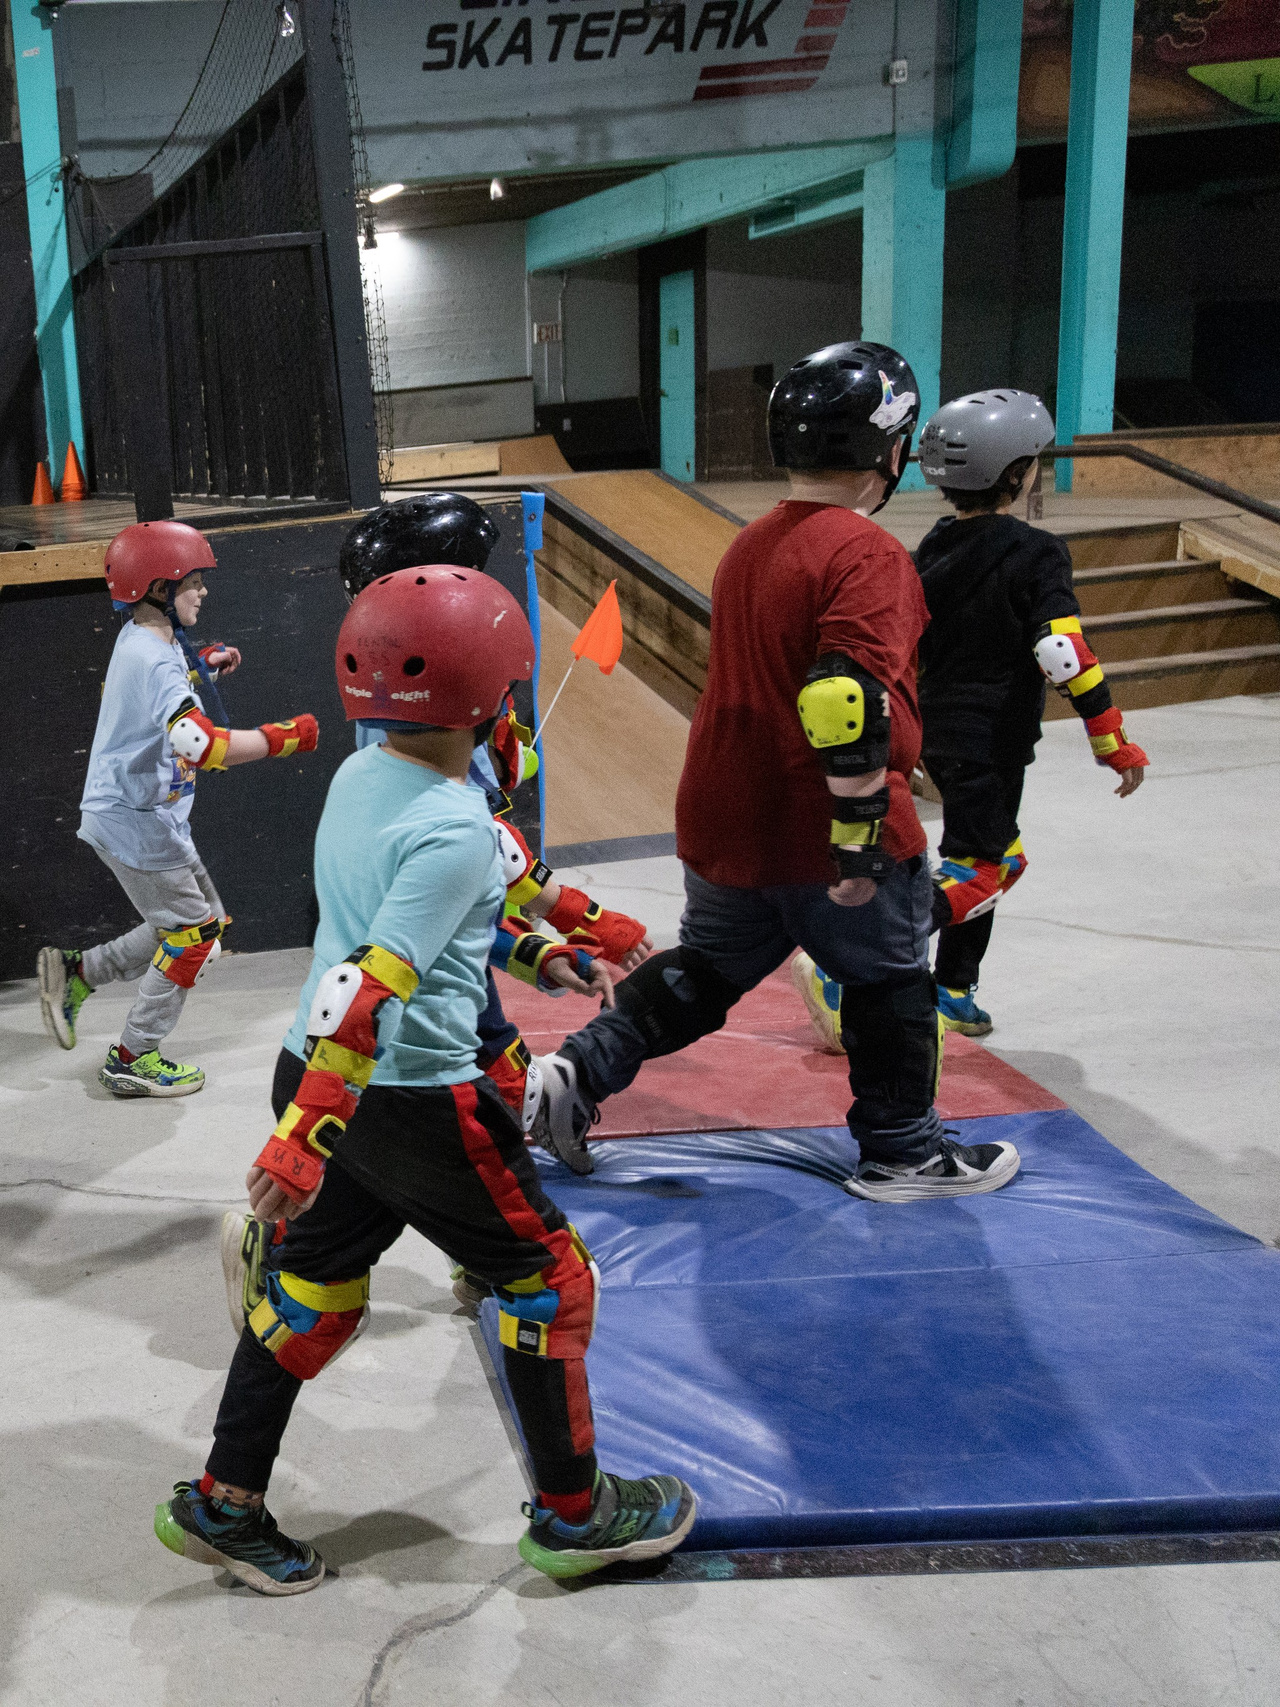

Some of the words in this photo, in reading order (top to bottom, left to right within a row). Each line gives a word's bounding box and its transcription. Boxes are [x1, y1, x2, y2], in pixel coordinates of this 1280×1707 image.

[422, 0, 781, 71] SKATEPARK
[345, 685, 373, 698] triple
[391, 690, 430, 702] eight
